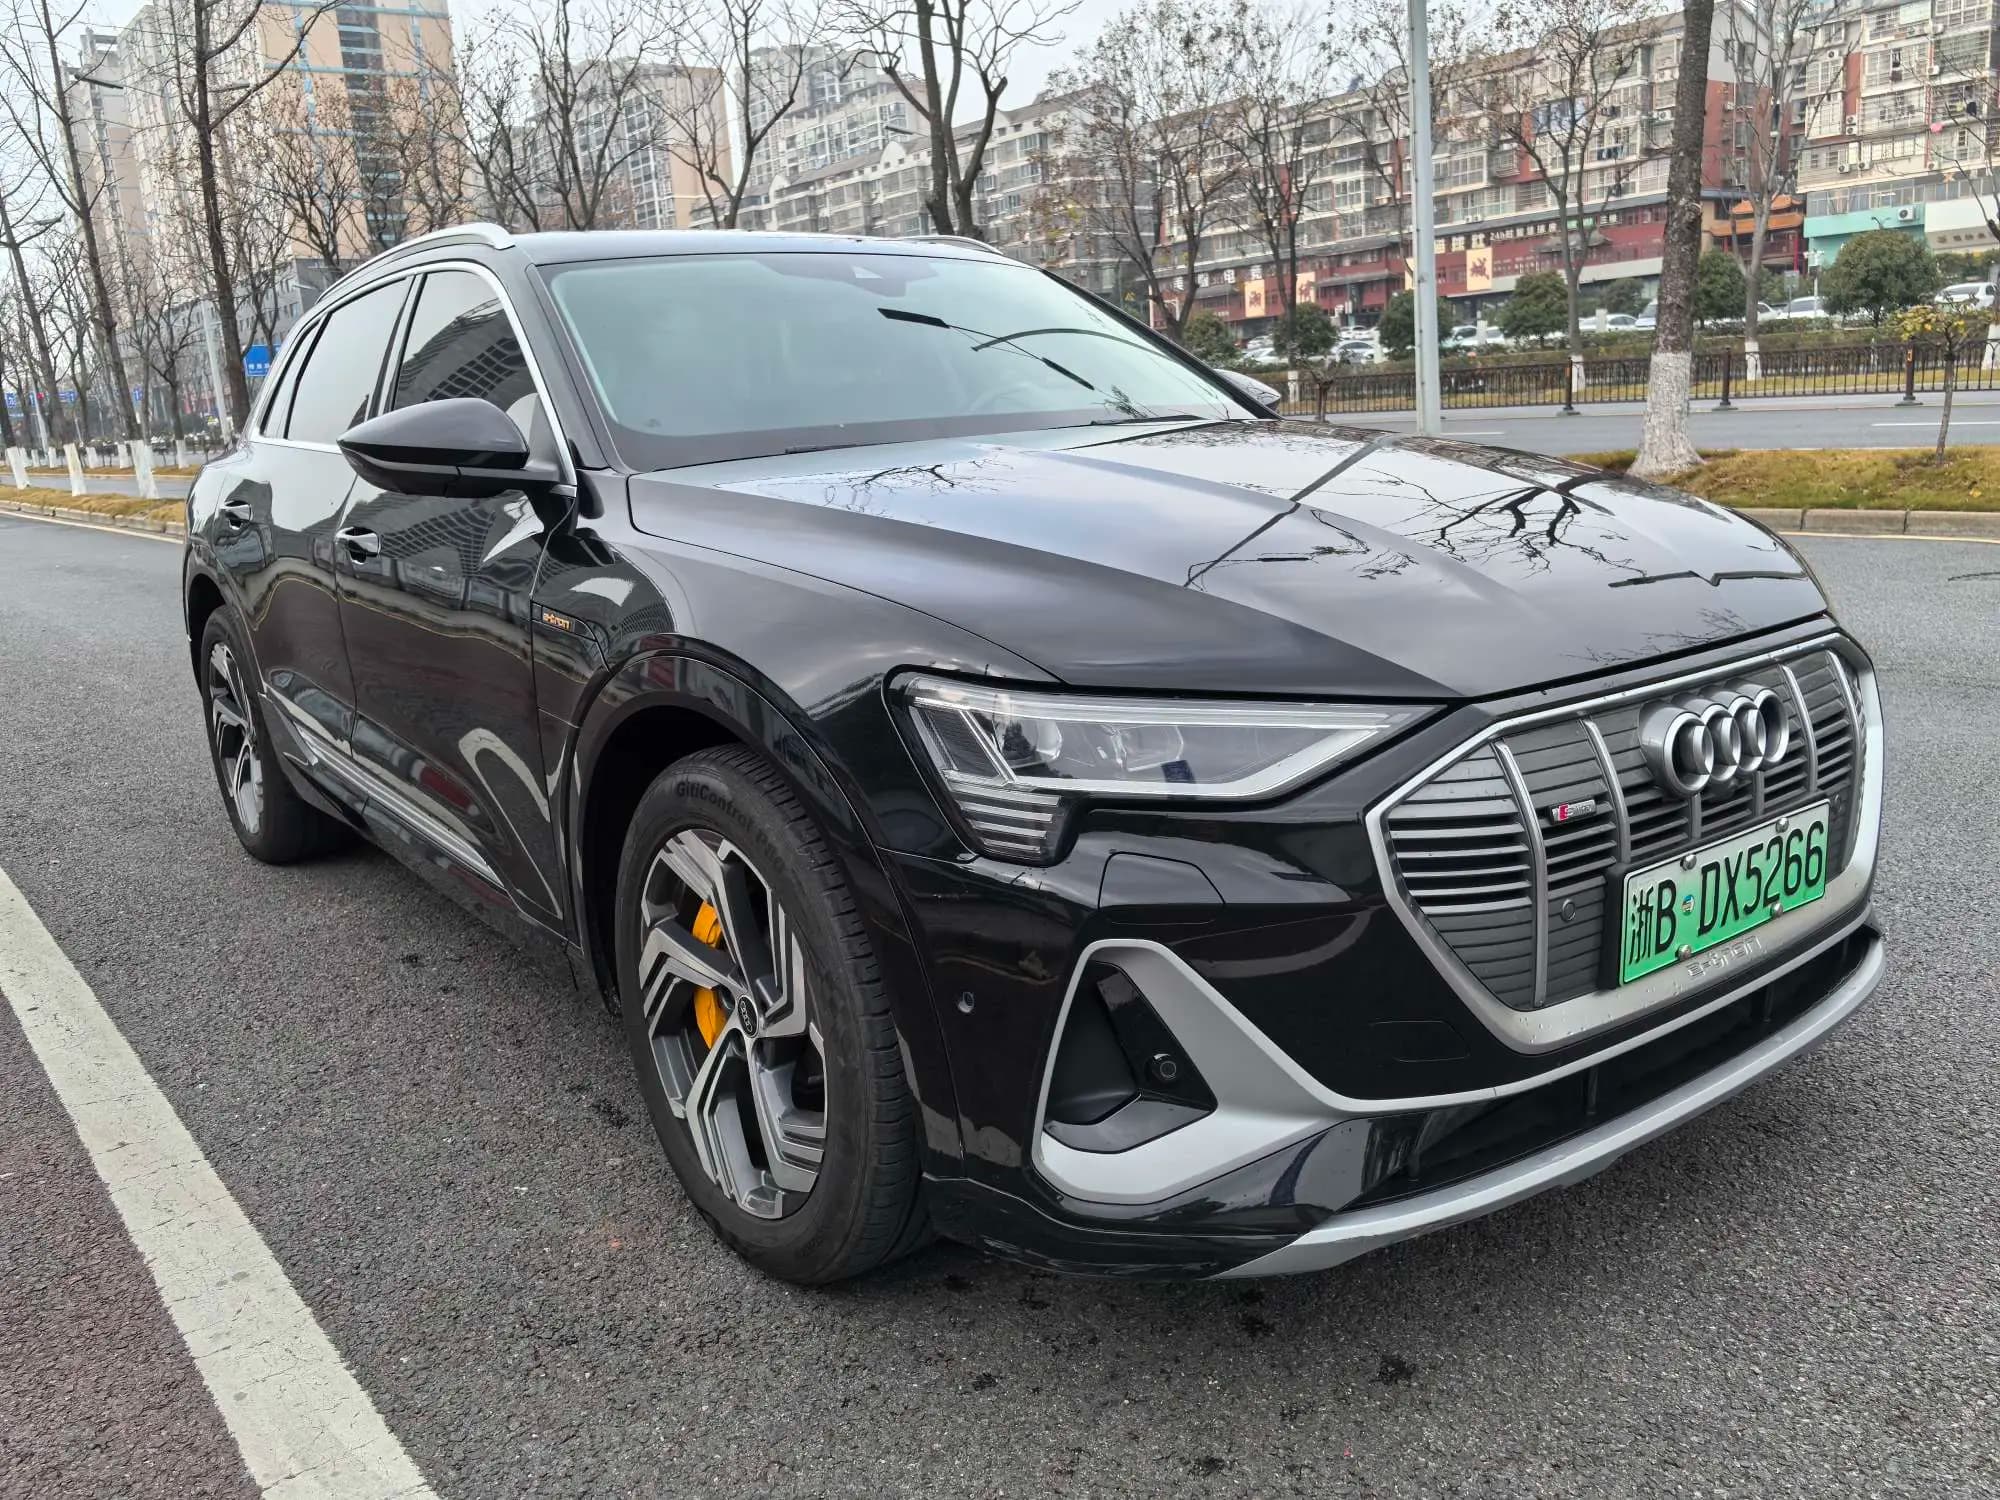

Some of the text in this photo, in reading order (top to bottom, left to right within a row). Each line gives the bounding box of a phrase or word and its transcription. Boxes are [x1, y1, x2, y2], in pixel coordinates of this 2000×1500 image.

[676, 781, 755, 832] GitiControl
[1629, 820, 1825, 964] 浙B DX5266
